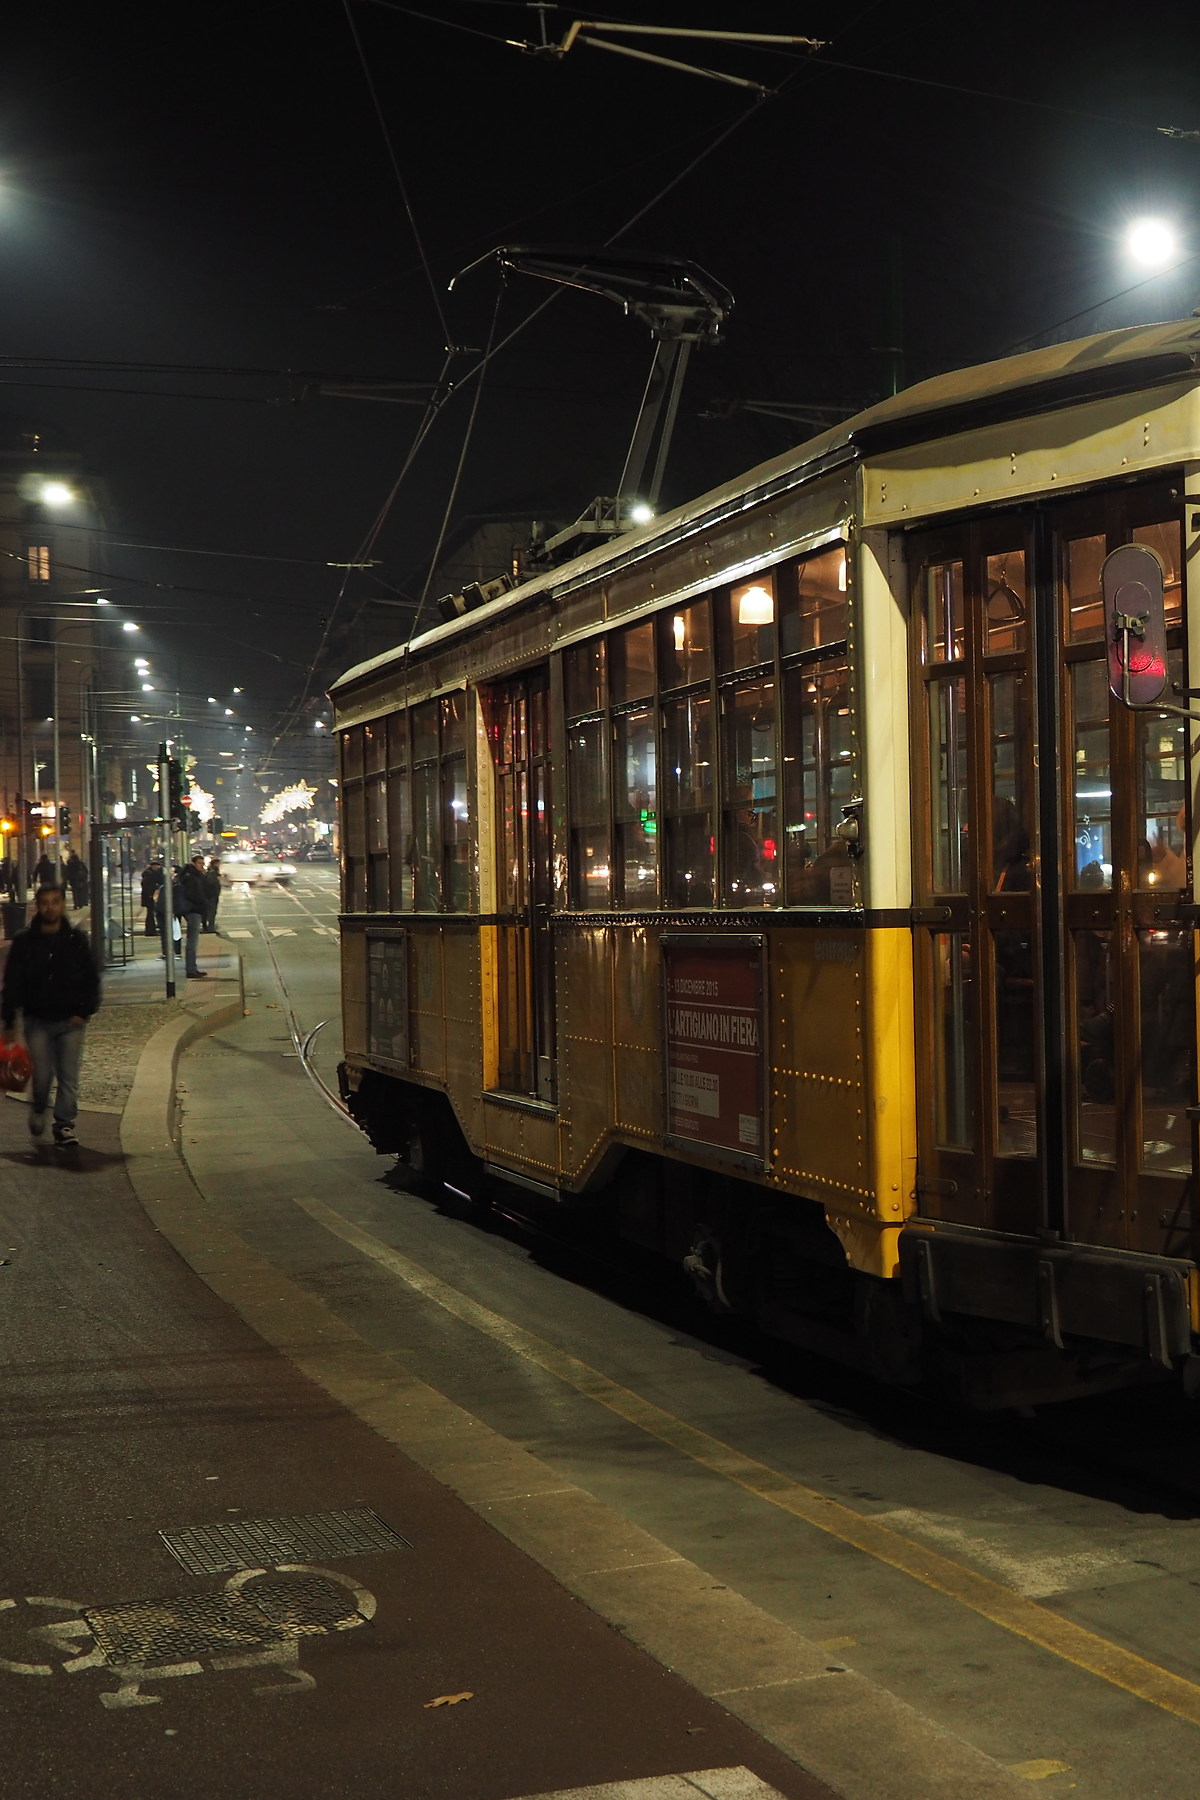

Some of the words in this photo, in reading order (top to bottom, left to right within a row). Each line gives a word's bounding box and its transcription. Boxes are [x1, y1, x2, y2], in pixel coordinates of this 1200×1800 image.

[680, 979, 705, 996] DICEMBRE
[706, 980, 719, 996] 2015
[668, 1009, 719, 1041] L'ARTIGIANO
[720, 1014, 730, 1042] IN
[731, 1015, 759, 1046] FIERA
